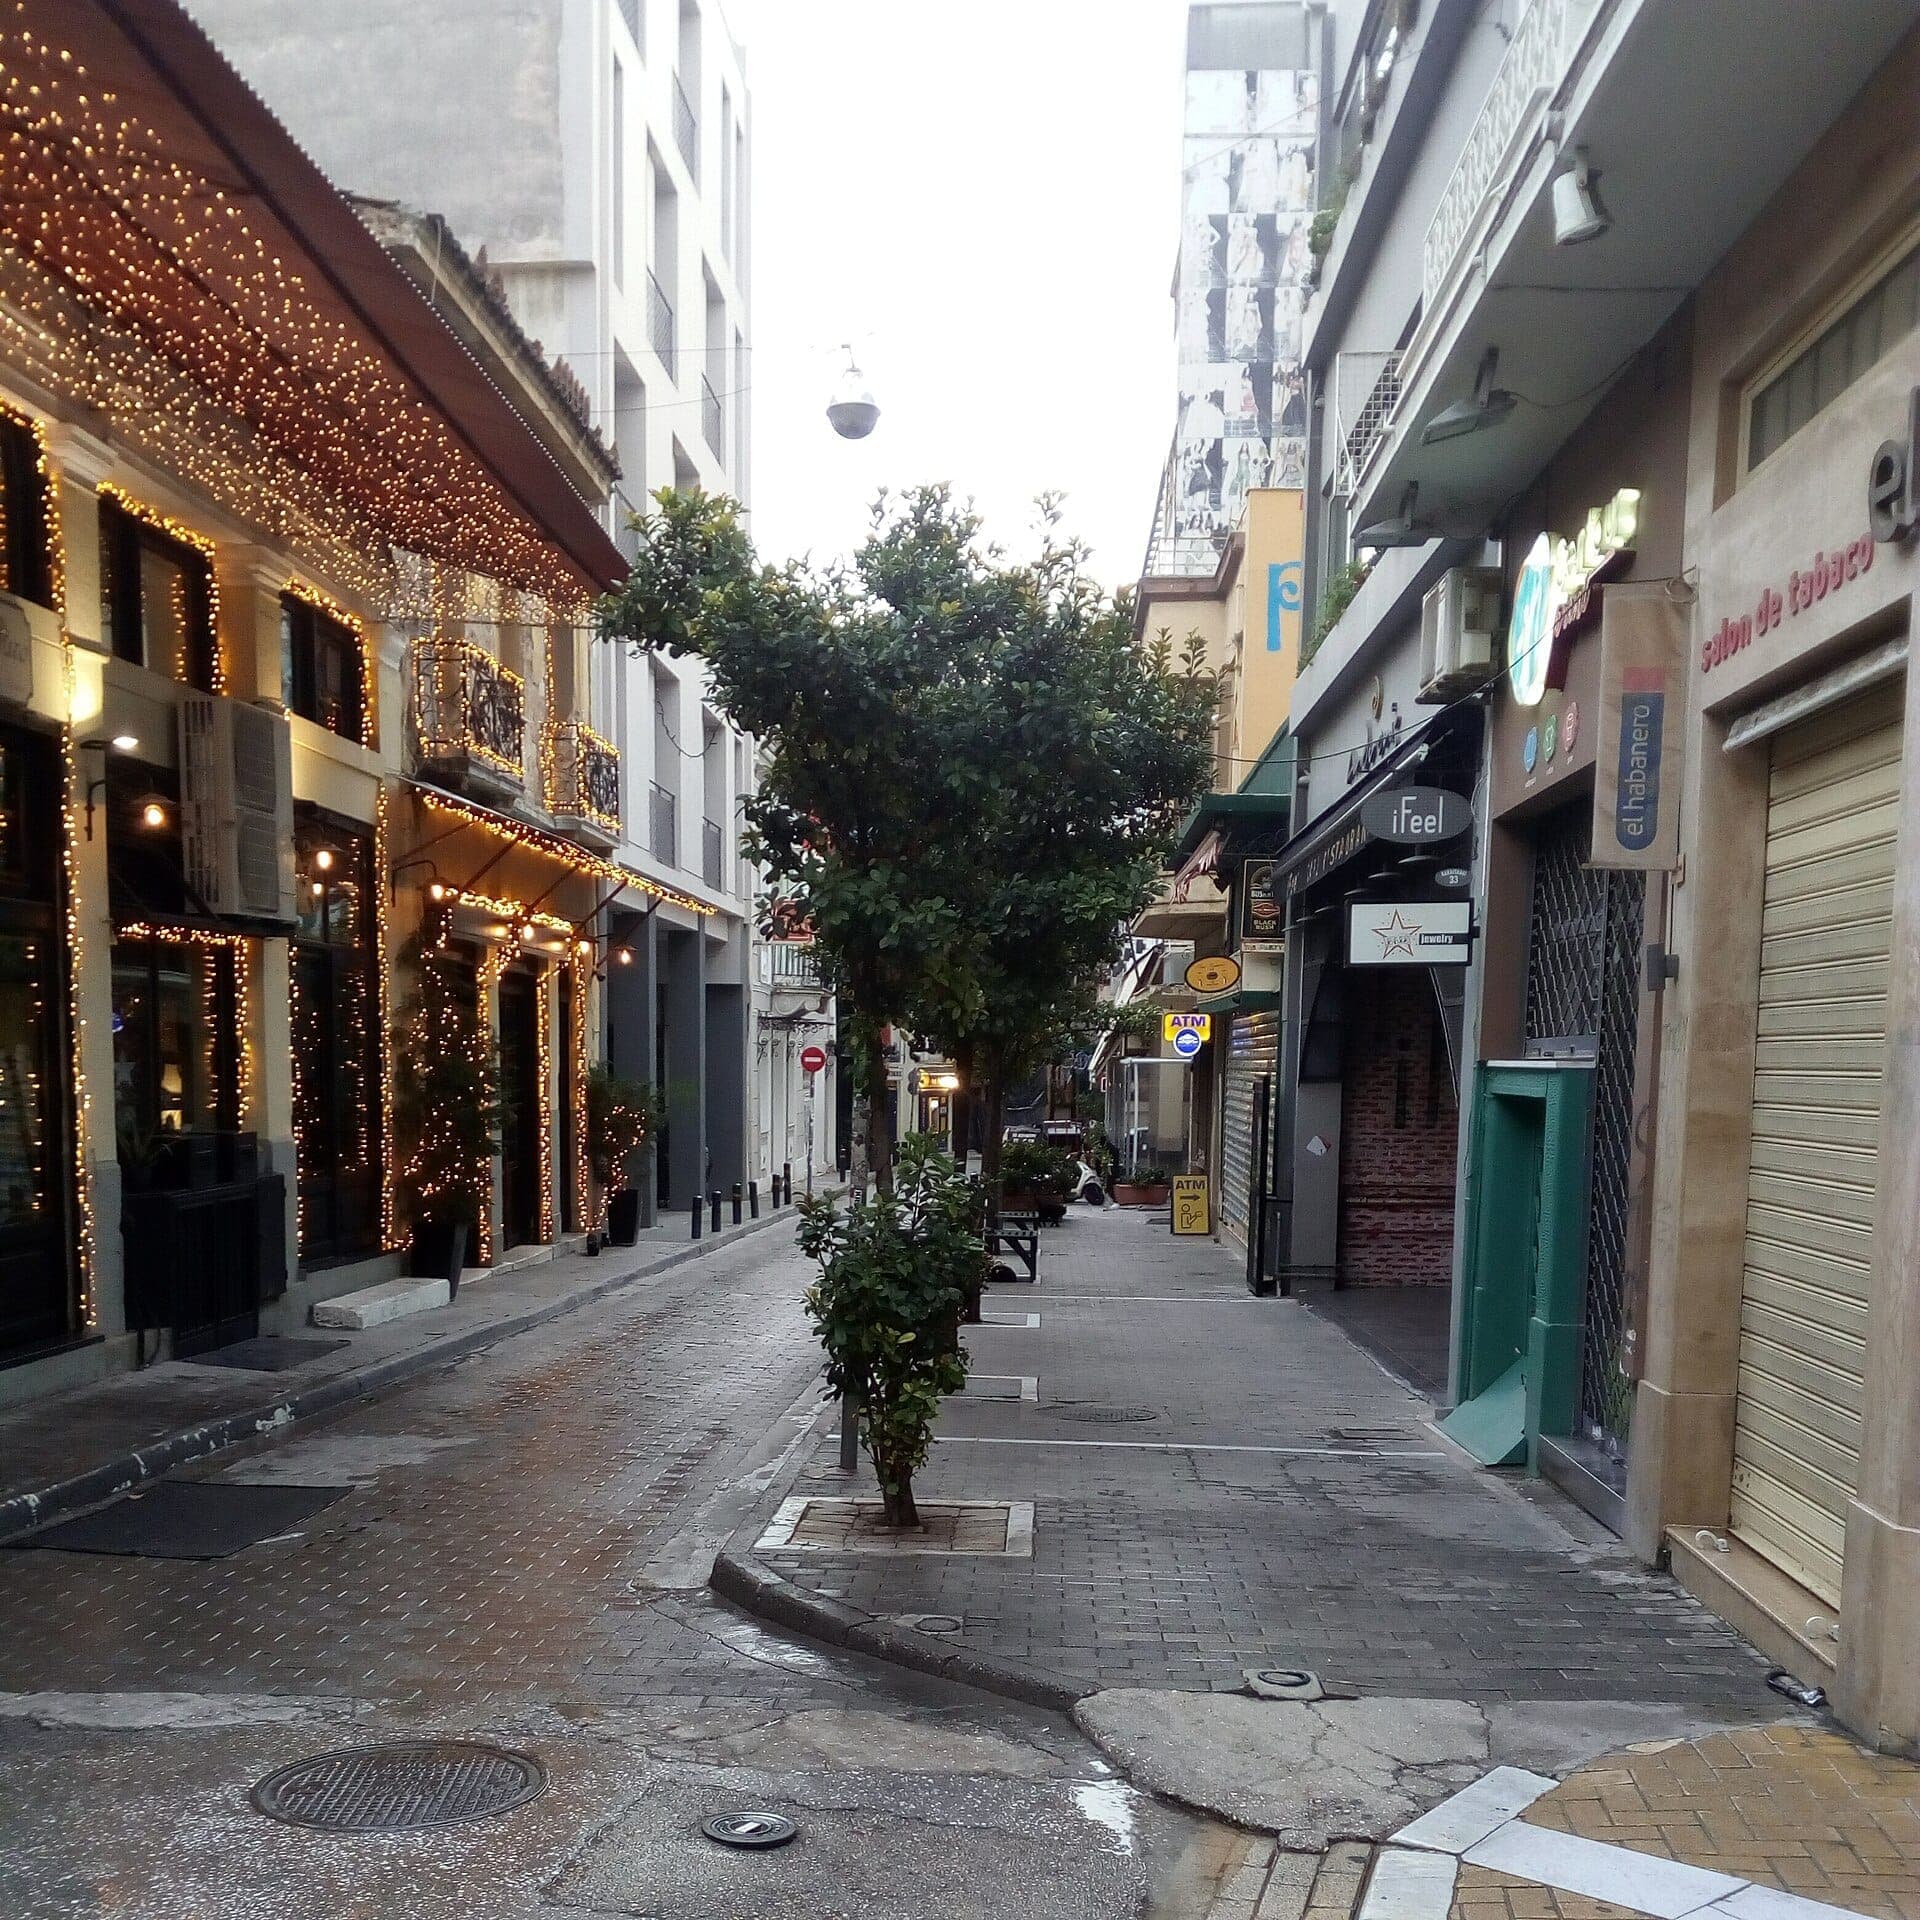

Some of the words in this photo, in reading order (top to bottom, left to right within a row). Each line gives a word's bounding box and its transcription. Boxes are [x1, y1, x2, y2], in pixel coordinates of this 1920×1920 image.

[1702, 614, 1752, 673] salon
[1756, 588, 1783, 637] de
[1789, 532, 1875, 616] tabaco
[1622, 704, 1650, 810] habanero
[1392, 796, 1444, 834] iFeel
[1622, 817, 1644, 836] el
[1449, 875, 1459, 884] 33
[1421, 934, 1453, 945] jewelry
[1171, 1016, 1206, 1028] ATM
[1175, 1179, 1206, 1190] ATM
